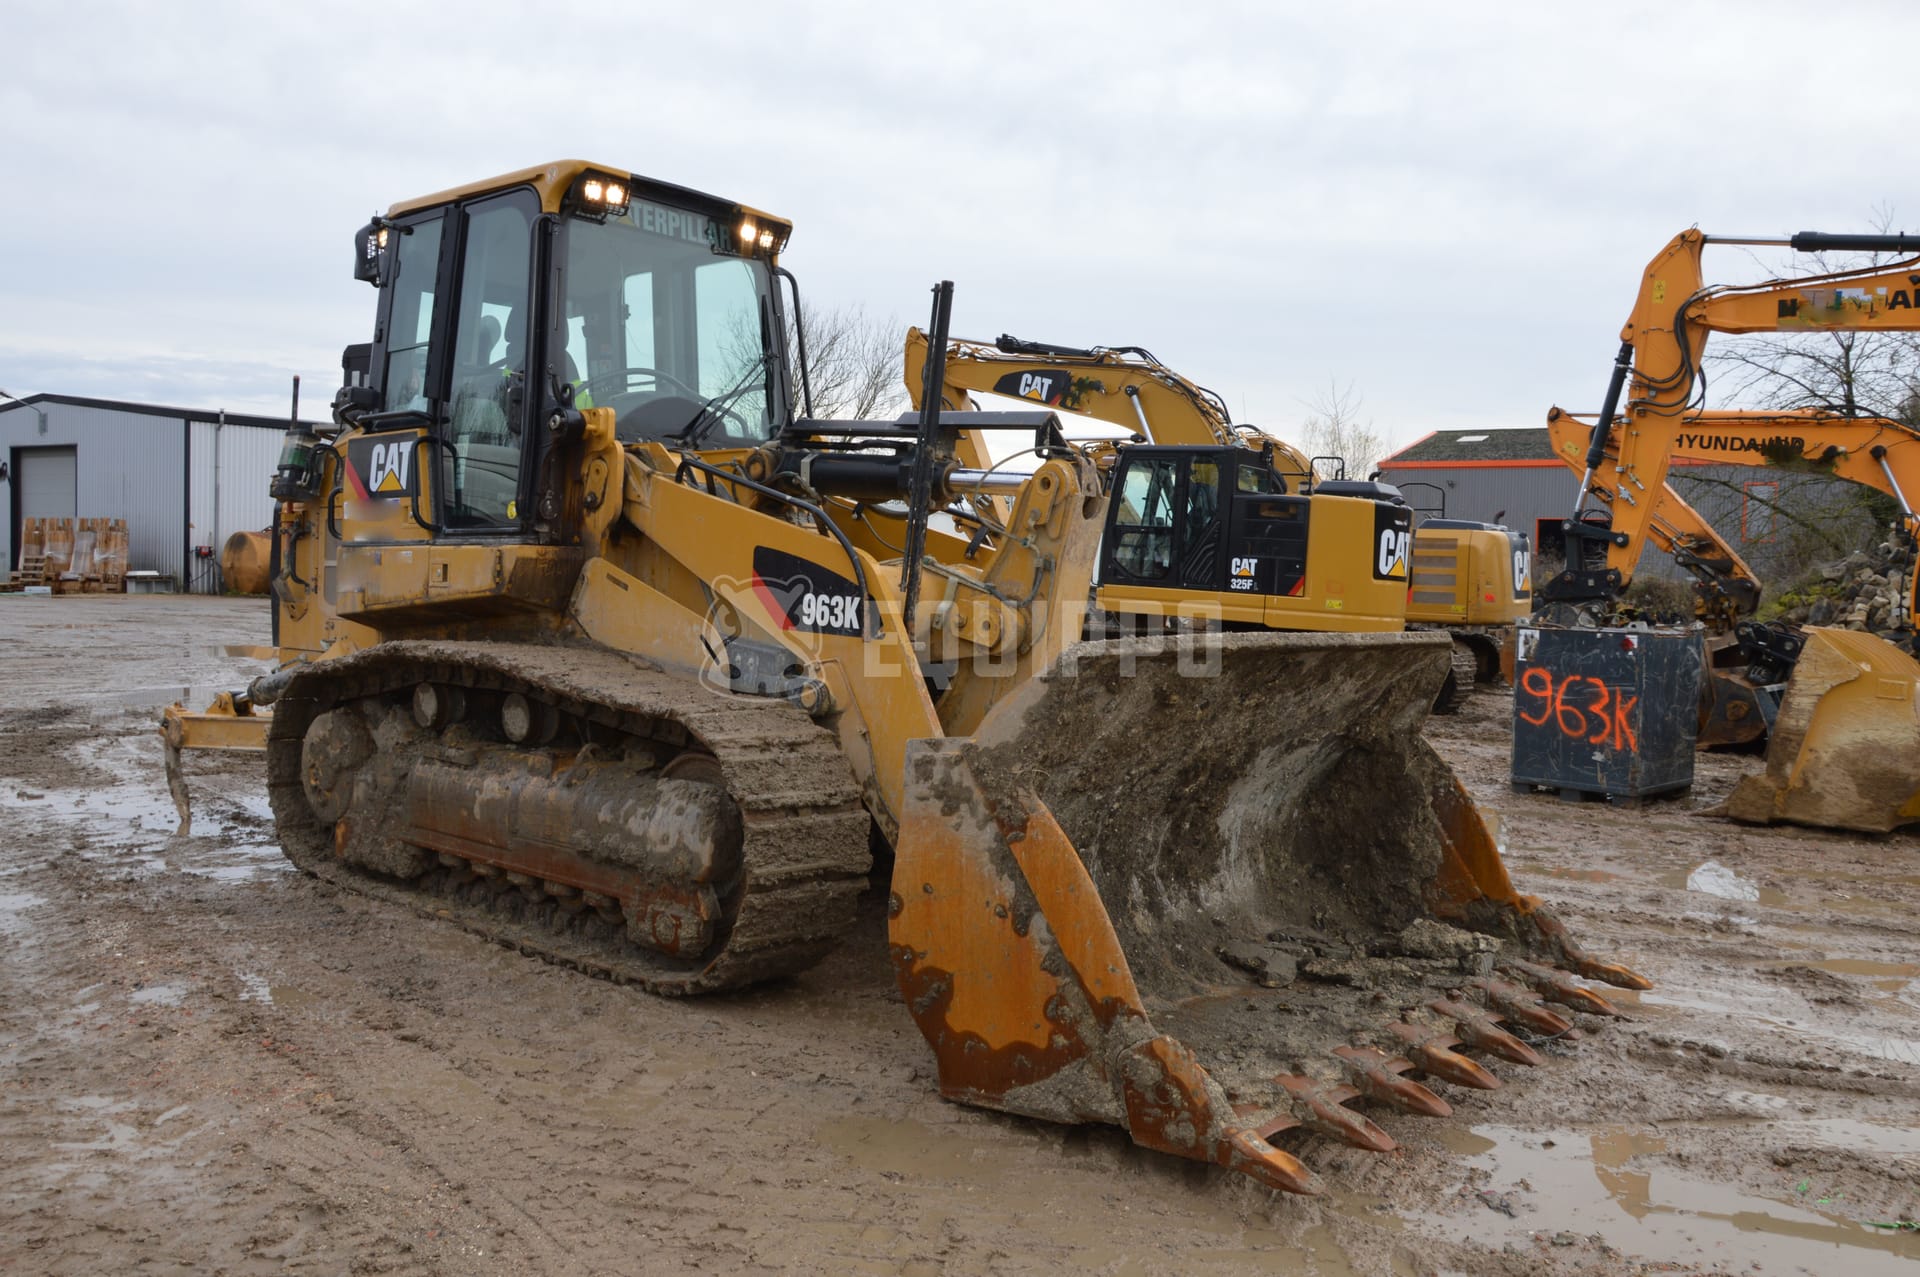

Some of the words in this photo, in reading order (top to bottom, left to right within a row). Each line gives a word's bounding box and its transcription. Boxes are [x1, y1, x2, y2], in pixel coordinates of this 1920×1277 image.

[1019, 372, 1053, 402] CAT
[369, 441, 414, 493] CAT
[1230, 578, 1254, 590] 325F
[1231, 557, 1258, 577] CAT
[802, 592, 861, 630] 963K
[1520, 667, 1638, 753] 963K
